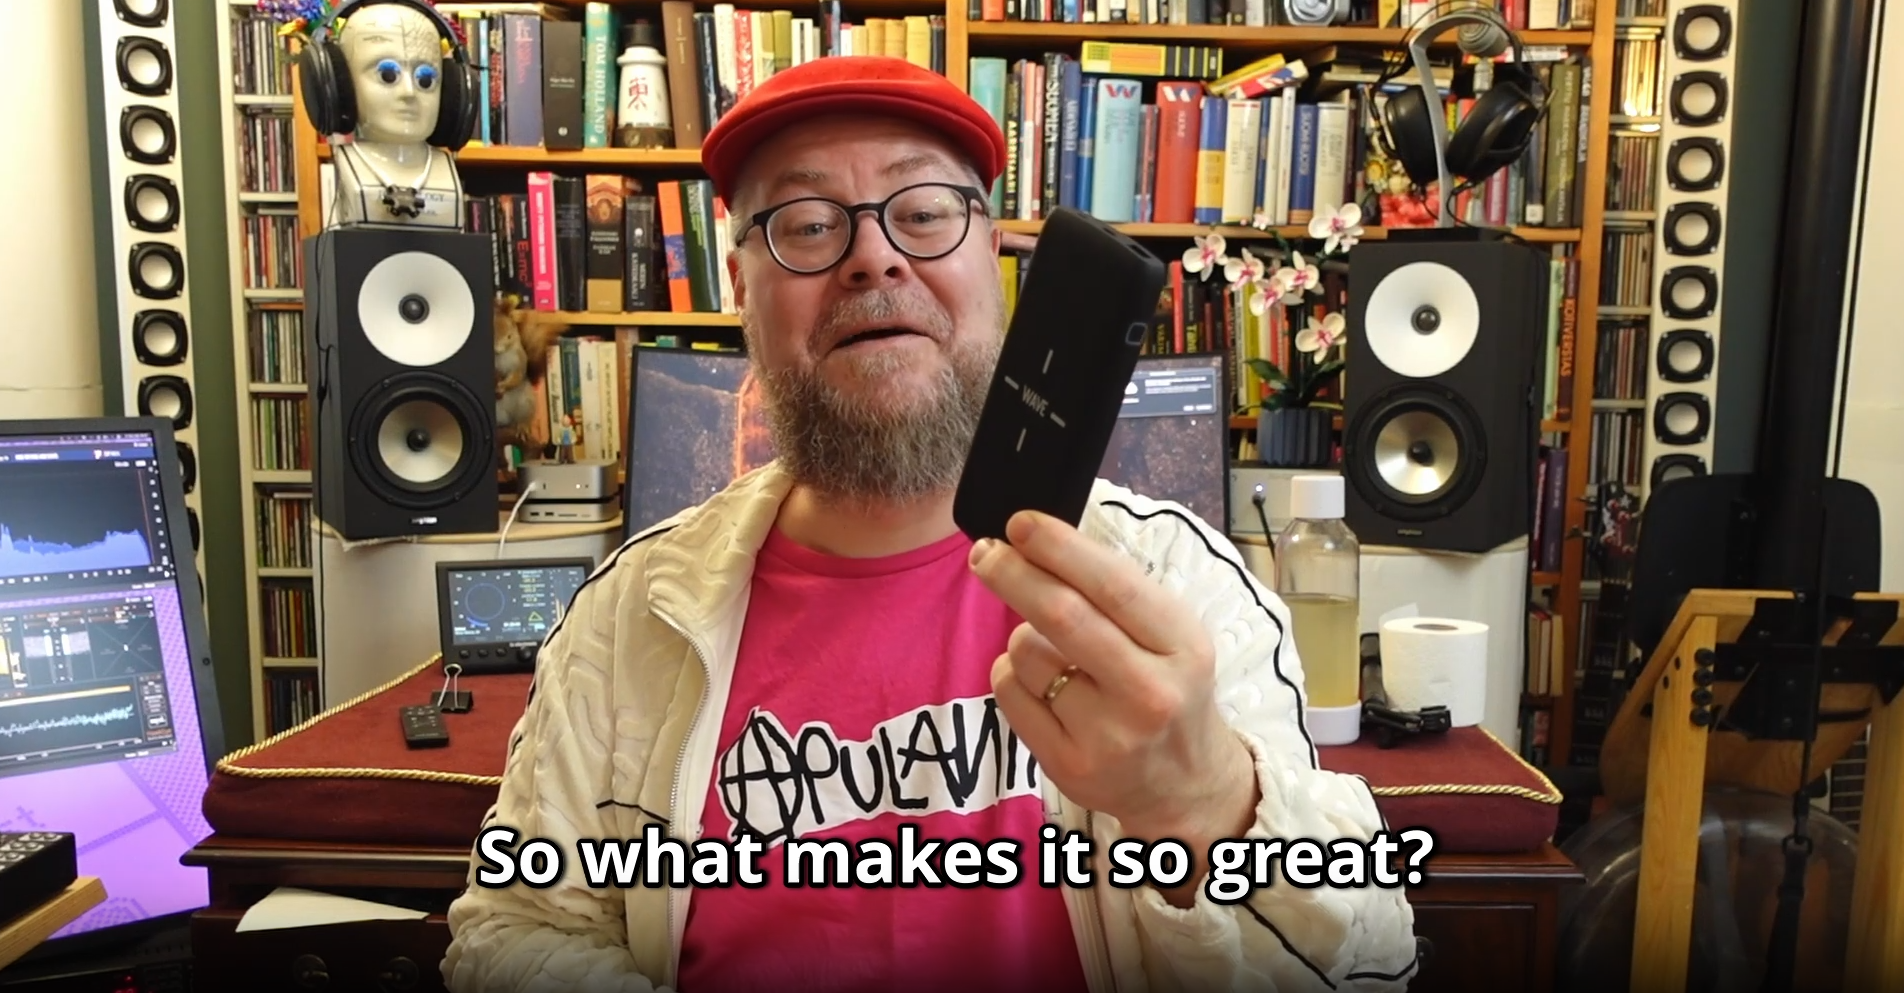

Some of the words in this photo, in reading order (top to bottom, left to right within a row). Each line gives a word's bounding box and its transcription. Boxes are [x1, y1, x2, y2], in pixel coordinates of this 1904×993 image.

[595, 35, 607, 64] TOM
[594, 69, 607, 134] HOLLAND
[1045, 82, 1059, 142] SUOMEN
[1007, 120, 1017, 193] AARRESAARI
[1560, 298, 1576, 377] KOTIVERSTAS
[1022, 384, 1049, 418] WAVE
